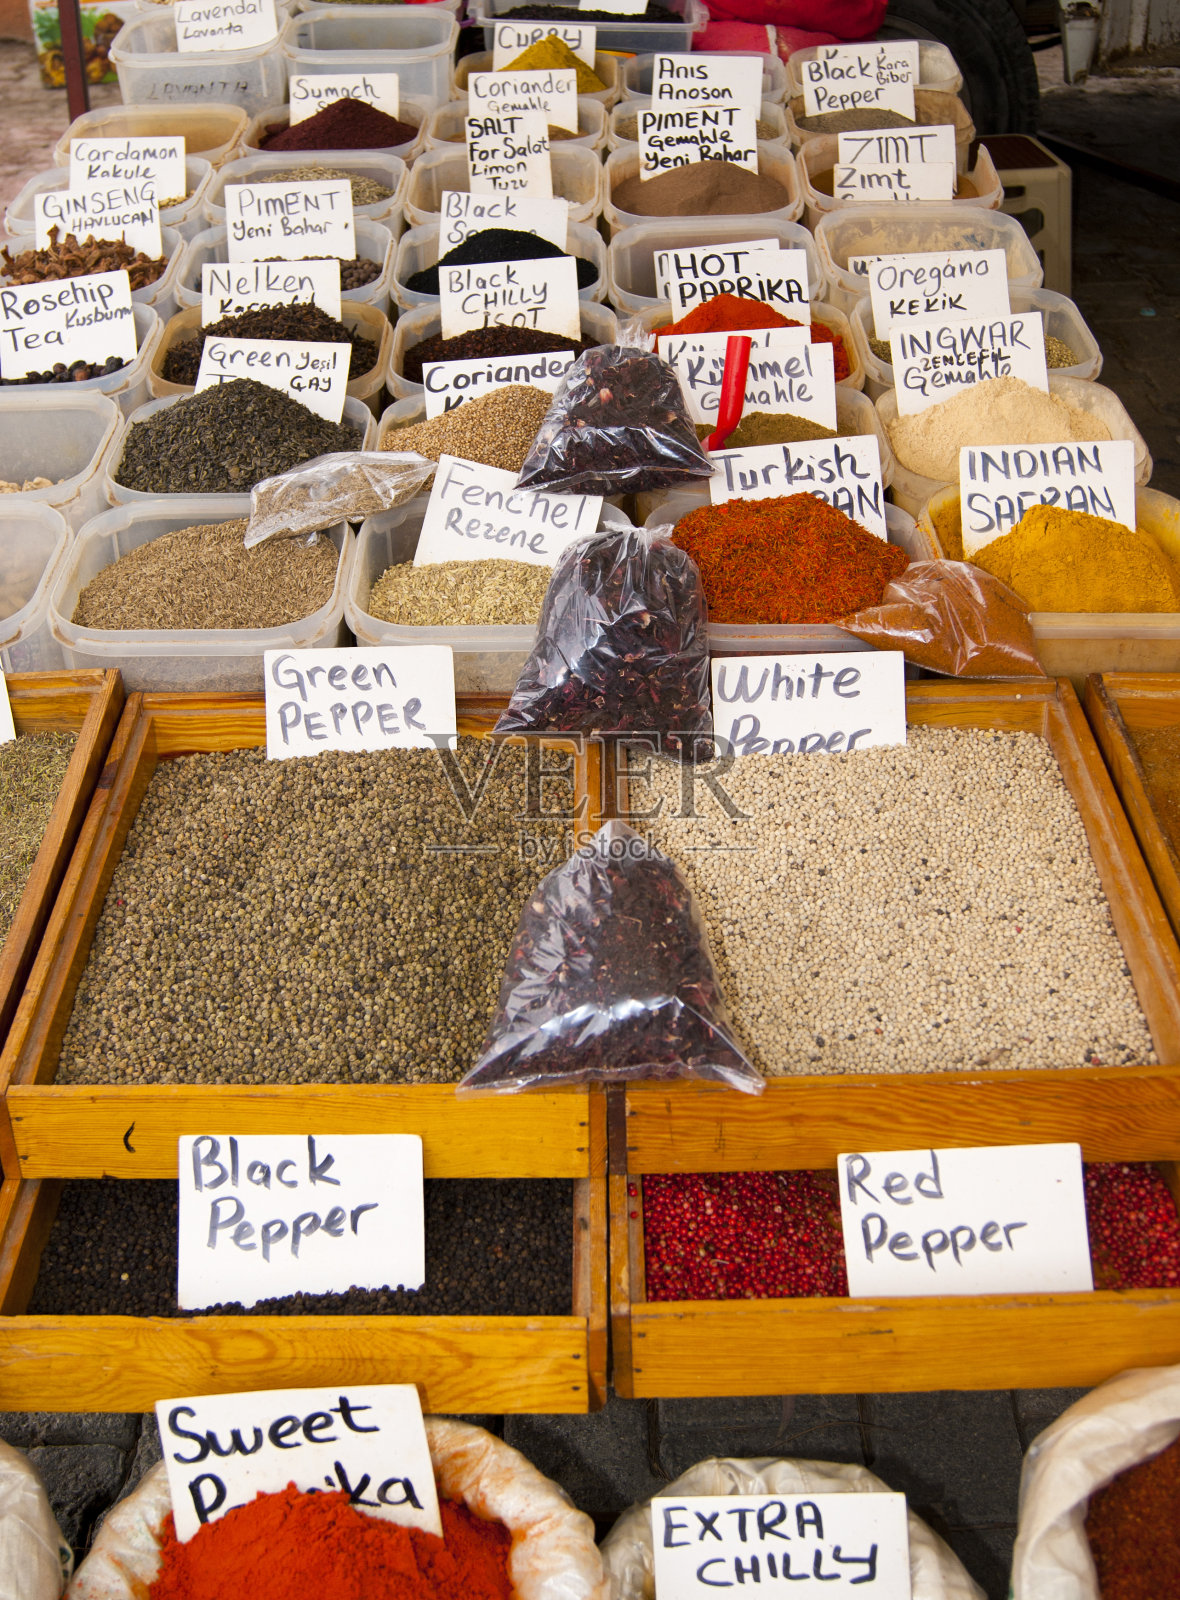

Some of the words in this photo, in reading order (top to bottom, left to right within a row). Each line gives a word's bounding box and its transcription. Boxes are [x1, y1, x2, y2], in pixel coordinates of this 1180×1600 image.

[808, 56, 872, 82] Black
[877, 55, 909, 70] Kara
[293, 76, 381, 100] Sumach
[474, 72, 576, 98] Coriander
[814, 86, 885, 111] Pepper
[468, 117, 523, 139] SALT
[642, 108, 741, 134] PIMENT
[75, 140, 178, 161] Cardamon
[469, 142, 500, 161] For
[503, 135, 550, 159] Salat
[648, 128, 734, 151] Gemahle
[87, 164, 156, 179] Kakule
[471, 161, 527, 176] Limon
[486, 176, 528, 190] Tuzu
[42, 181, 157, 223] GINSENG
[238, 188, 341, 217] PIMENT
[446, 192, 517, 218] Black
[280, 216, 333, 236] Bahar
[449, 264, 519, 293] Black
[674, 251, 749, 279] HOT
[877, 260, 989, 298] Oregano
[209, 265, 315, 296] Nelken
[1, 281, 114, 320] Rosehip
[462, 282, 547, 314] CHILLY
[3, 327, 64, 352] Tea
[900, 320, 1031, 360] INGWAR
[208, 343, 291, 370] Green
[712, 443, 871, 492] Turkish
[968, 445, 1103, 483] INDIAN
[440, 462, 587, 532] Fenchel
[444, 507, 549, 555] Rezene
[271, 654, 398, 703] Green
[717, 662, 862, 704] White
[277, 697, 427, 746] PEPPER
[191, 1135, 341, 1193] Black
[845, 1148, 944, 1205] Red
[206, 1195, 379, 1263] Pepper
[861, 1212, 1028, 1273] Pepper
[167, 1395, 381, 1464] Sweet
[663, 1500, 825, 1548] EXTRA
[696, 1543, 878, 1587] CHILLY
